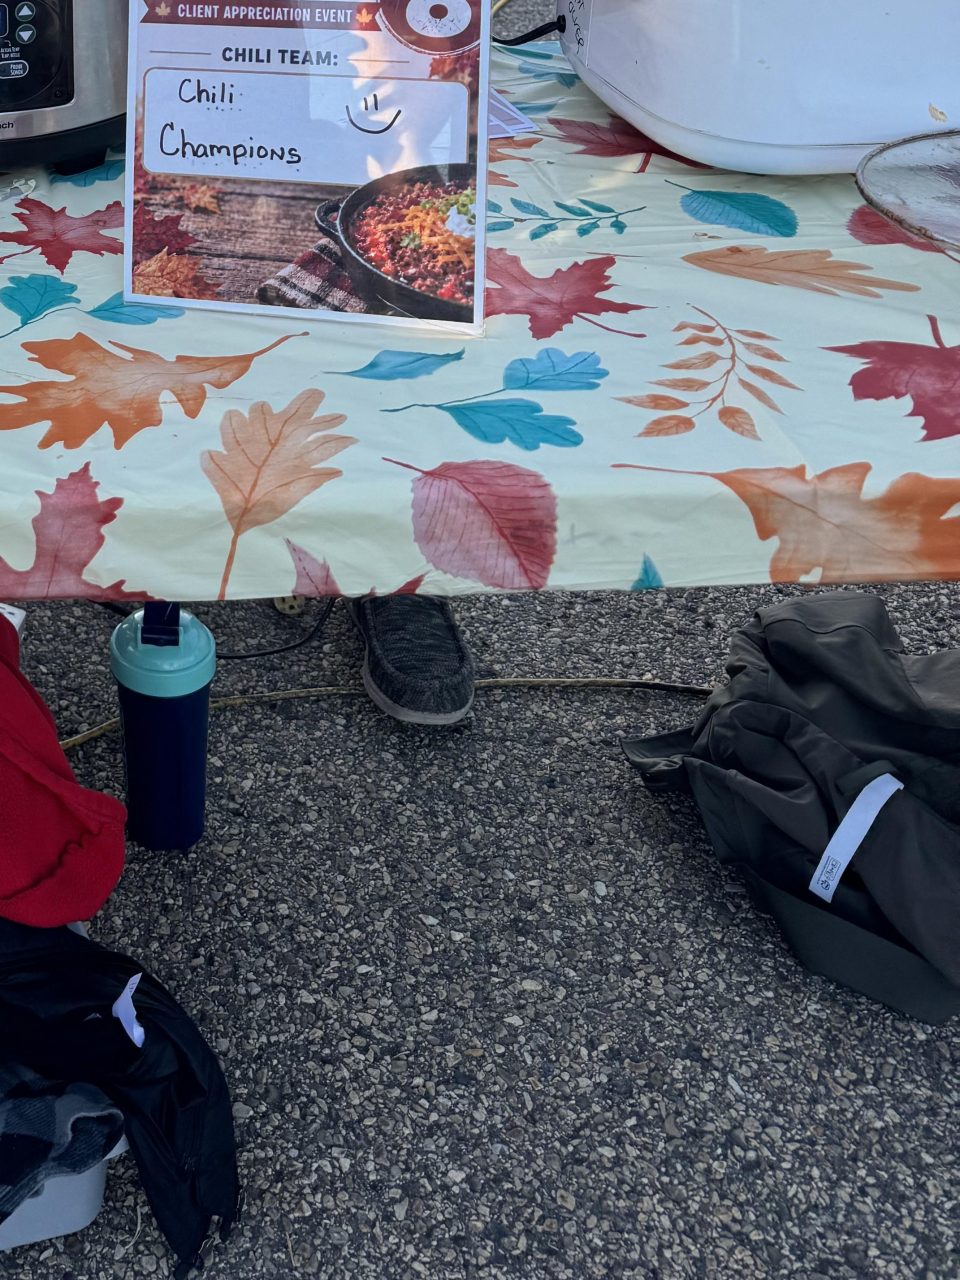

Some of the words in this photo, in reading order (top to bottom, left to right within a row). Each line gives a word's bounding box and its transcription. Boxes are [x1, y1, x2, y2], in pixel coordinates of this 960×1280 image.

[177, 3, 220, 19] CLIENT
[224, 5, 311, 22] APPRECIATION
[315, 8, 354, 24] EVENT
[221, 47, 272, 64] CHILI
[278, 49, 339, 67] TEAM:
[178, 78, 235, 104] Chili
